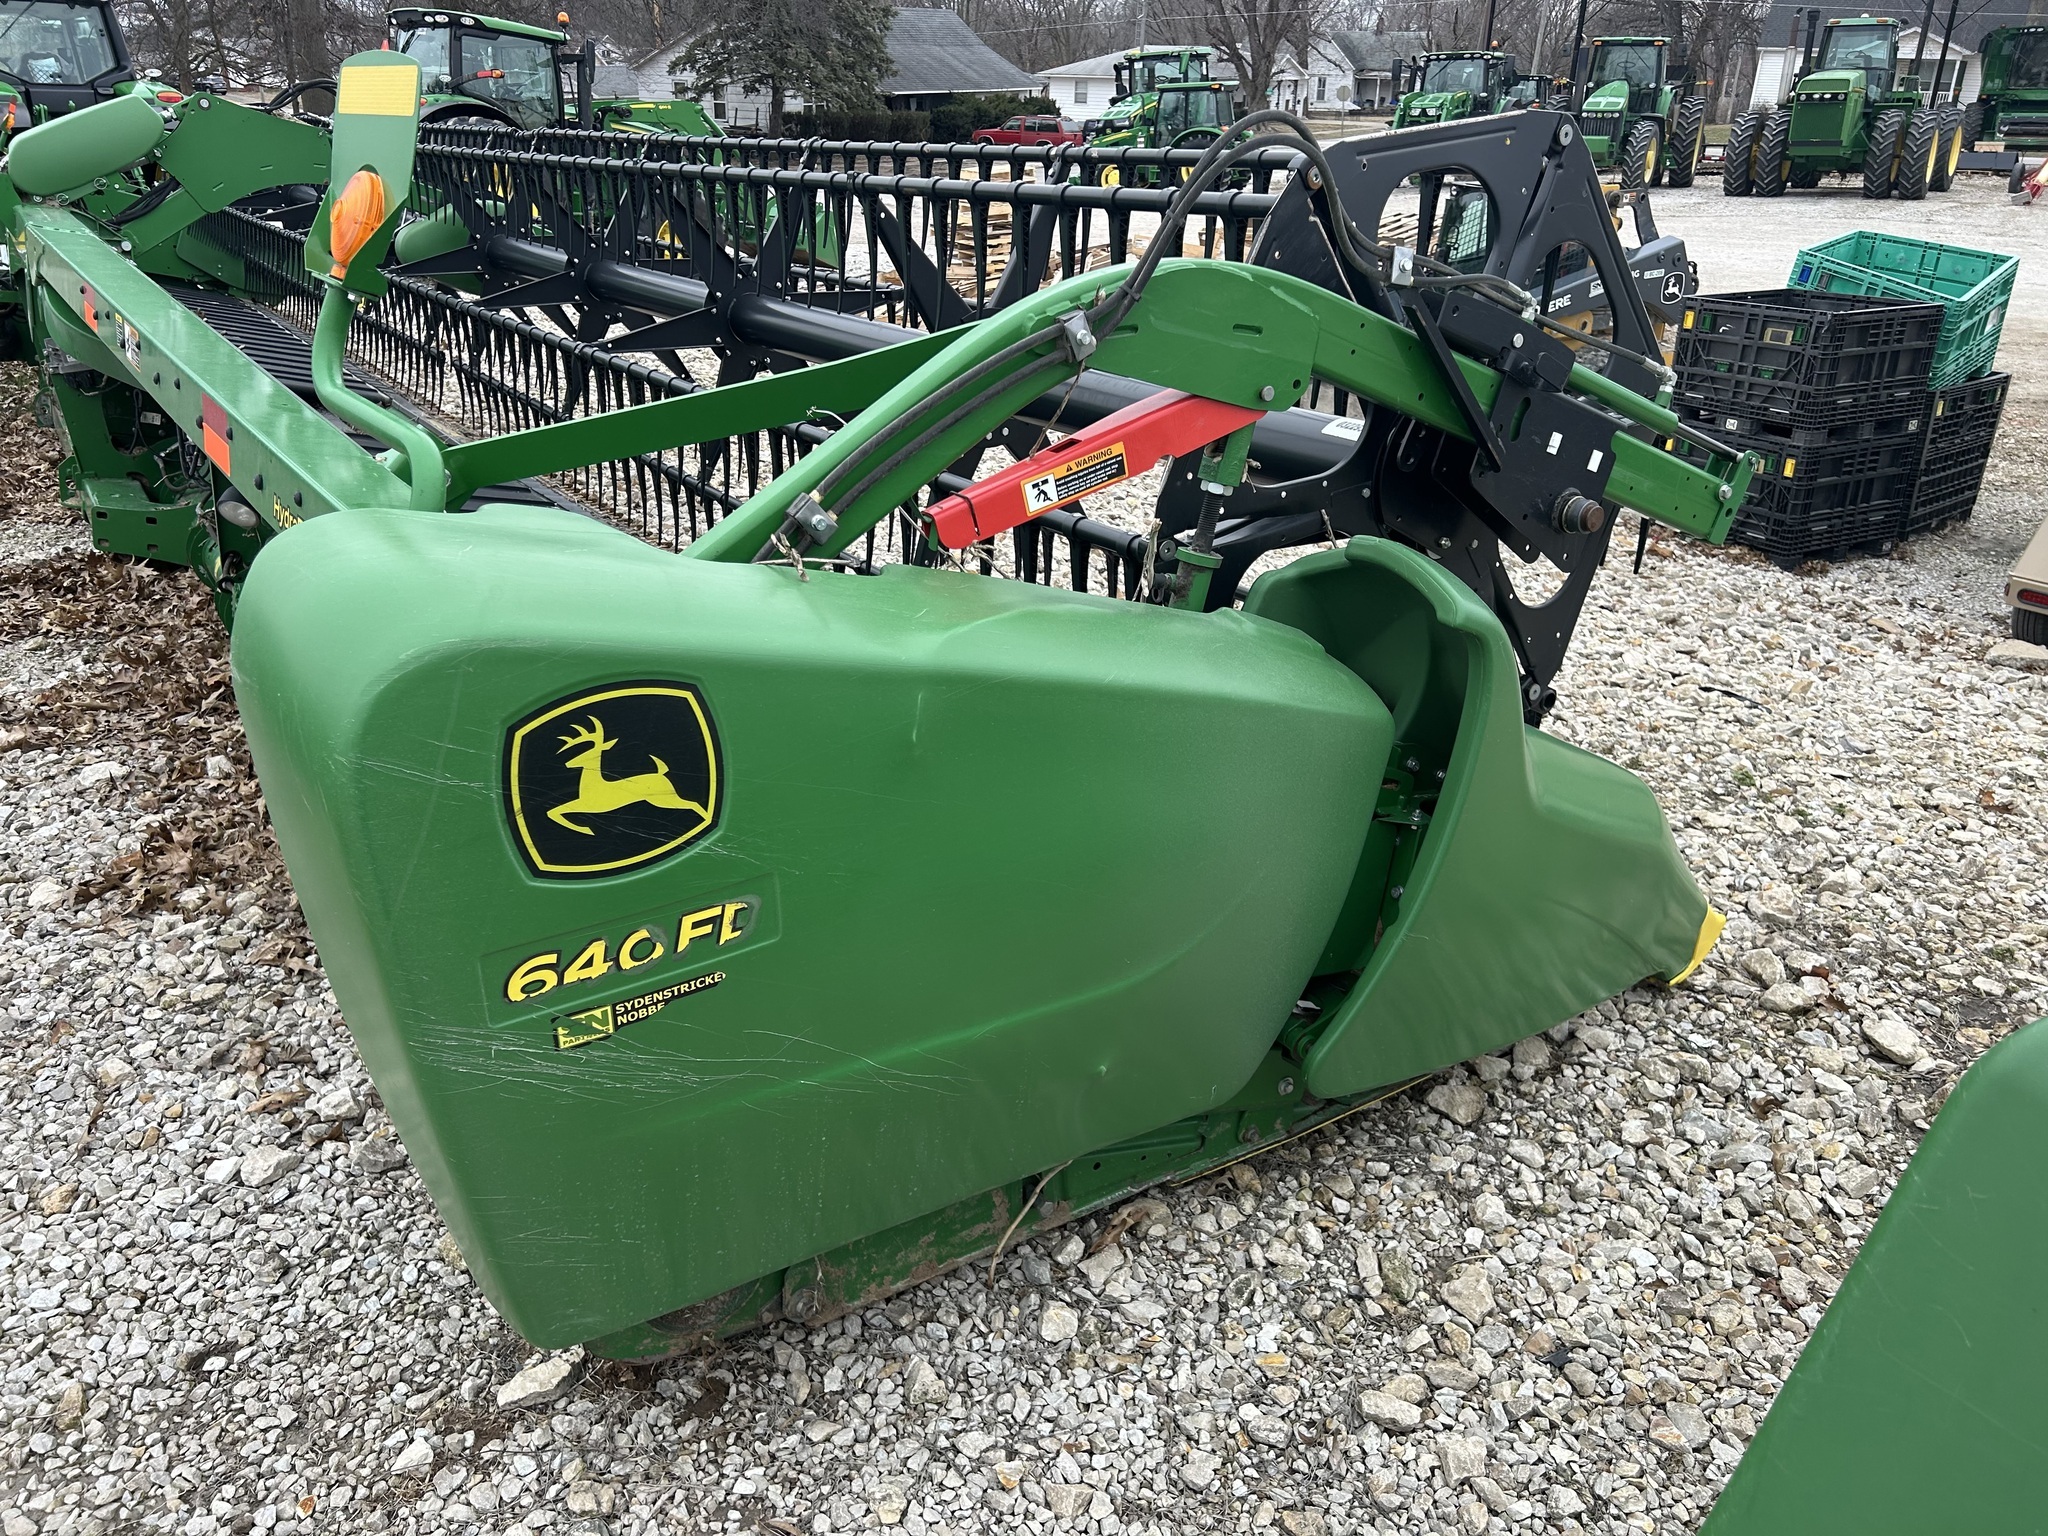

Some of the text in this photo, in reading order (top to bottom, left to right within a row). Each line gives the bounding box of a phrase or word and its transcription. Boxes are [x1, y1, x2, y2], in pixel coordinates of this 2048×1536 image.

[1075, 448, 1113, 469] WARNING
[506, 928, 665, 1003] 640
[615, 971, 726, 1014] SYDENSTRICKE
